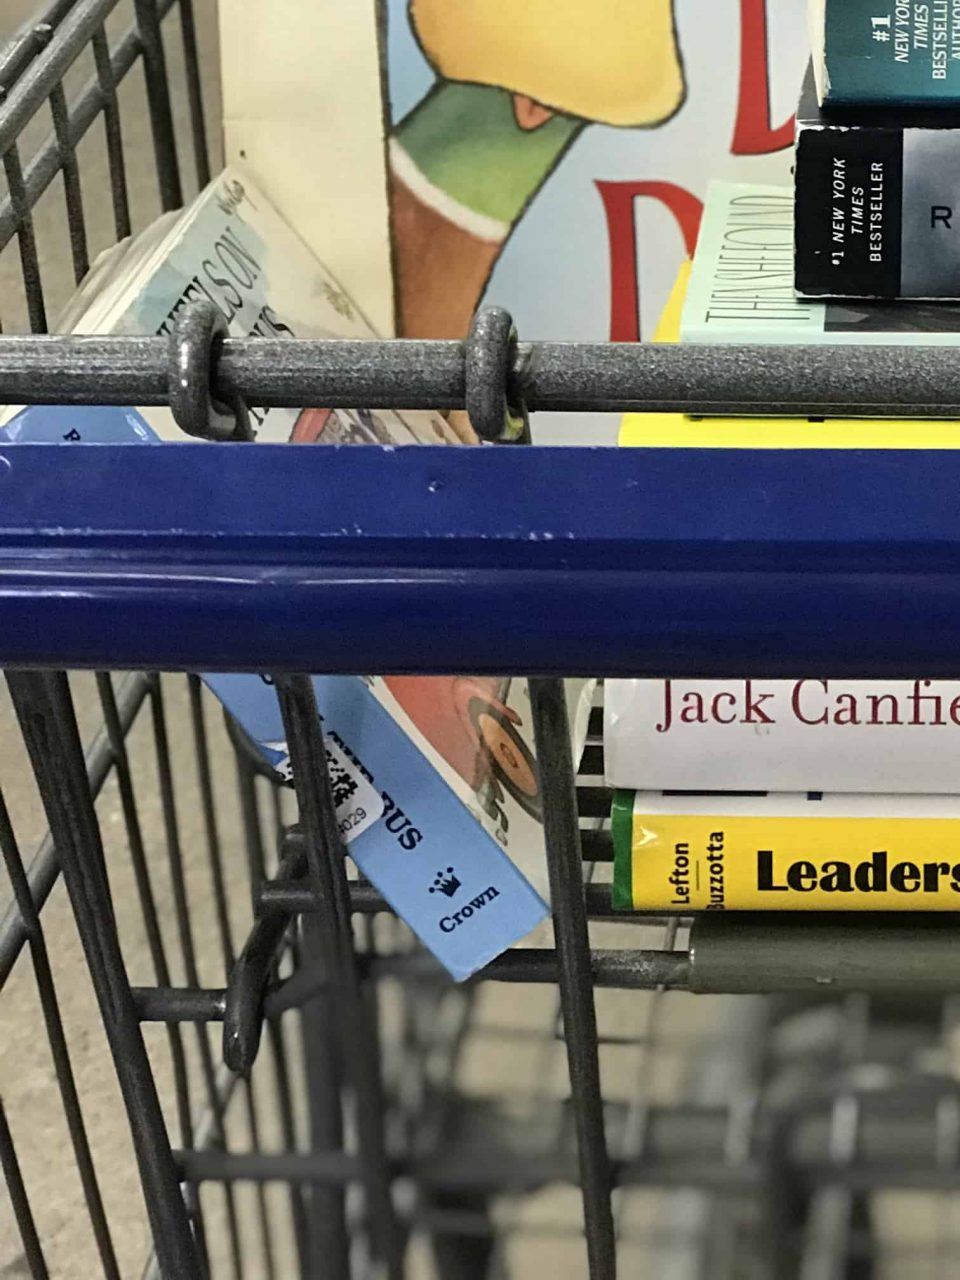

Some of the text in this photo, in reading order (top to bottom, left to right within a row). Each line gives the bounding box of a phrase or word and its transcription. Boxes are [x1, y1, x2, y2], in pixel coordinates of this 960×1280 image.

[870, 14, 891, 42] #1
[894, 28, 909, 63] NEW
[914, 3, 929, 49] TIMES
[831, 157, 846, 266] #1 NEW YORK
[851, 186, 864, 234] TIMES
[869, 162, 884, 262] BESTSELLER
[656, 680, 775, 733] Jack
[669, 843, 690, 904] Lefton
[438, 885, 500, 933] Crown
